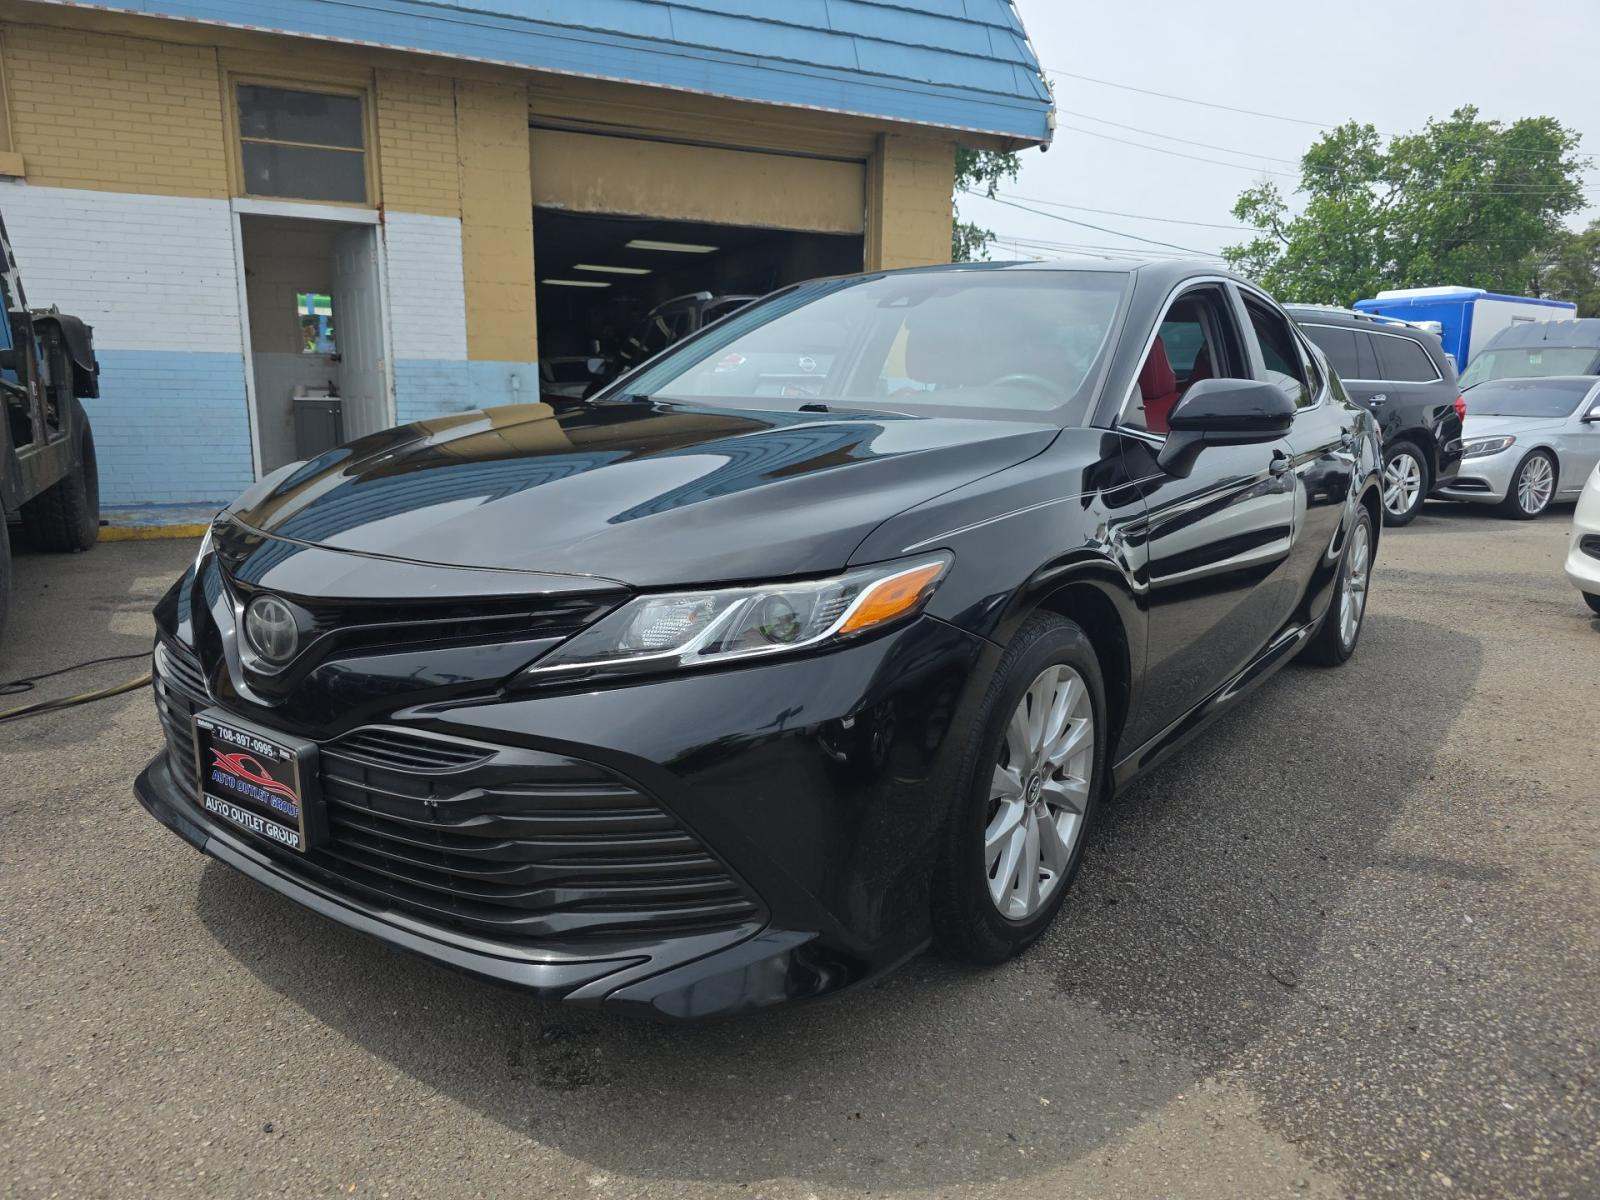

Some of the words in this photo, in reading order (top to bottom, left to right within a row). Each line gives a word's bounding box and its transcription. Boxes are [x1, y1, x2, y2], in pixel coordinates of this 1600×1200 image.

[218, 727, 273, 757] 708-897-0995
[212, 770, 236, 789] AUTO
[238, 780, 270, 804] OUTLET
[206, 796, 229, 815] AUTO
[231, 808, 264, 832] OUTLET
[266, 823, 298, 847] GROUP
